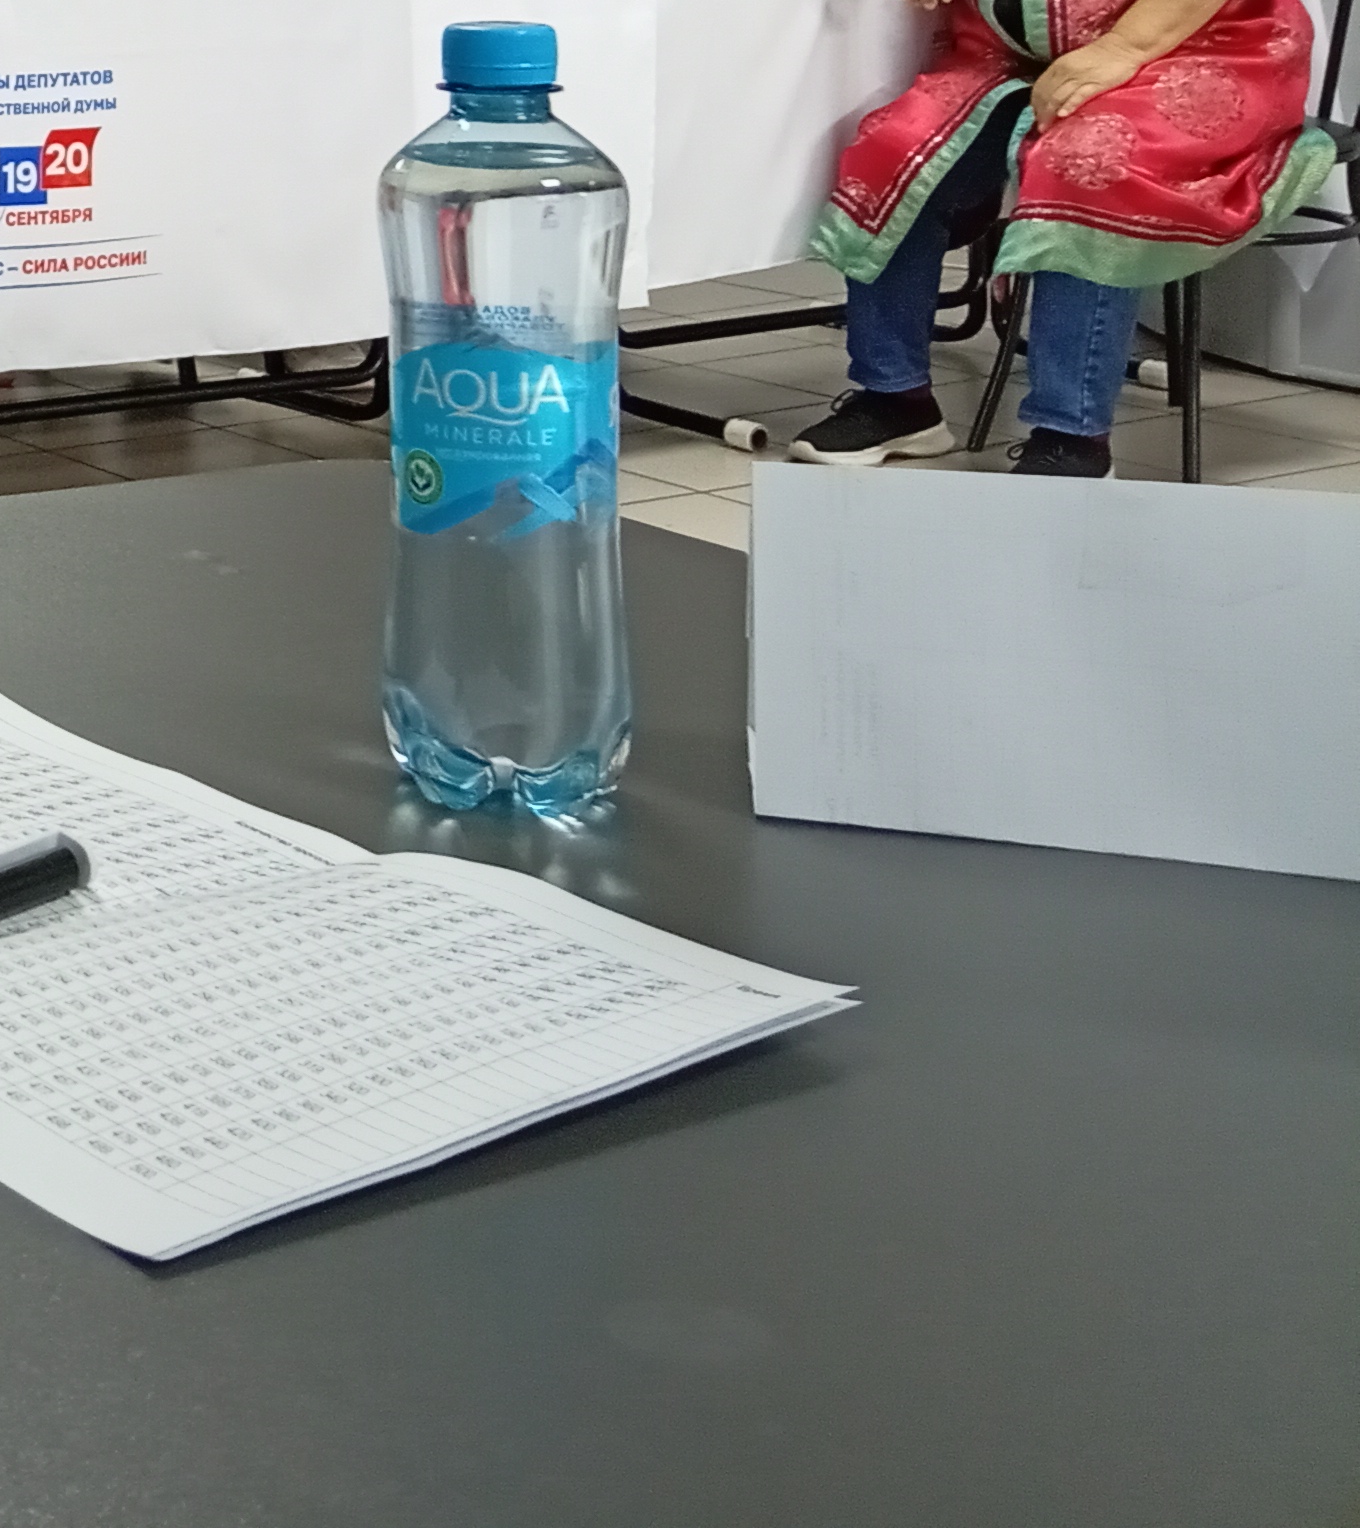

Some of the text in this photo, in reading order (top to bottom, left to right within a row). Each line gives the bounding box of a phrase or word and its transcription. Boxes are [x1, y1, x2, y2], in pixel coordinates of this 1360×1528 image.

[14, 70, 114, 91] ДЕПУТАТОВ
[74, 97, 117, 113] ДУМЫ
[1, 161, 37, 194] 19
[45, 142, 89, 175] 20
[5, 208, 93, 227] СЕНТЯБРЯ
[22, 258, 69, 274] СИЛА
[73, 250, 147, 271] РОССИИ!
[412, 358, 569, 425] AQUA
[425, 424, 557, 446] MINERALE
